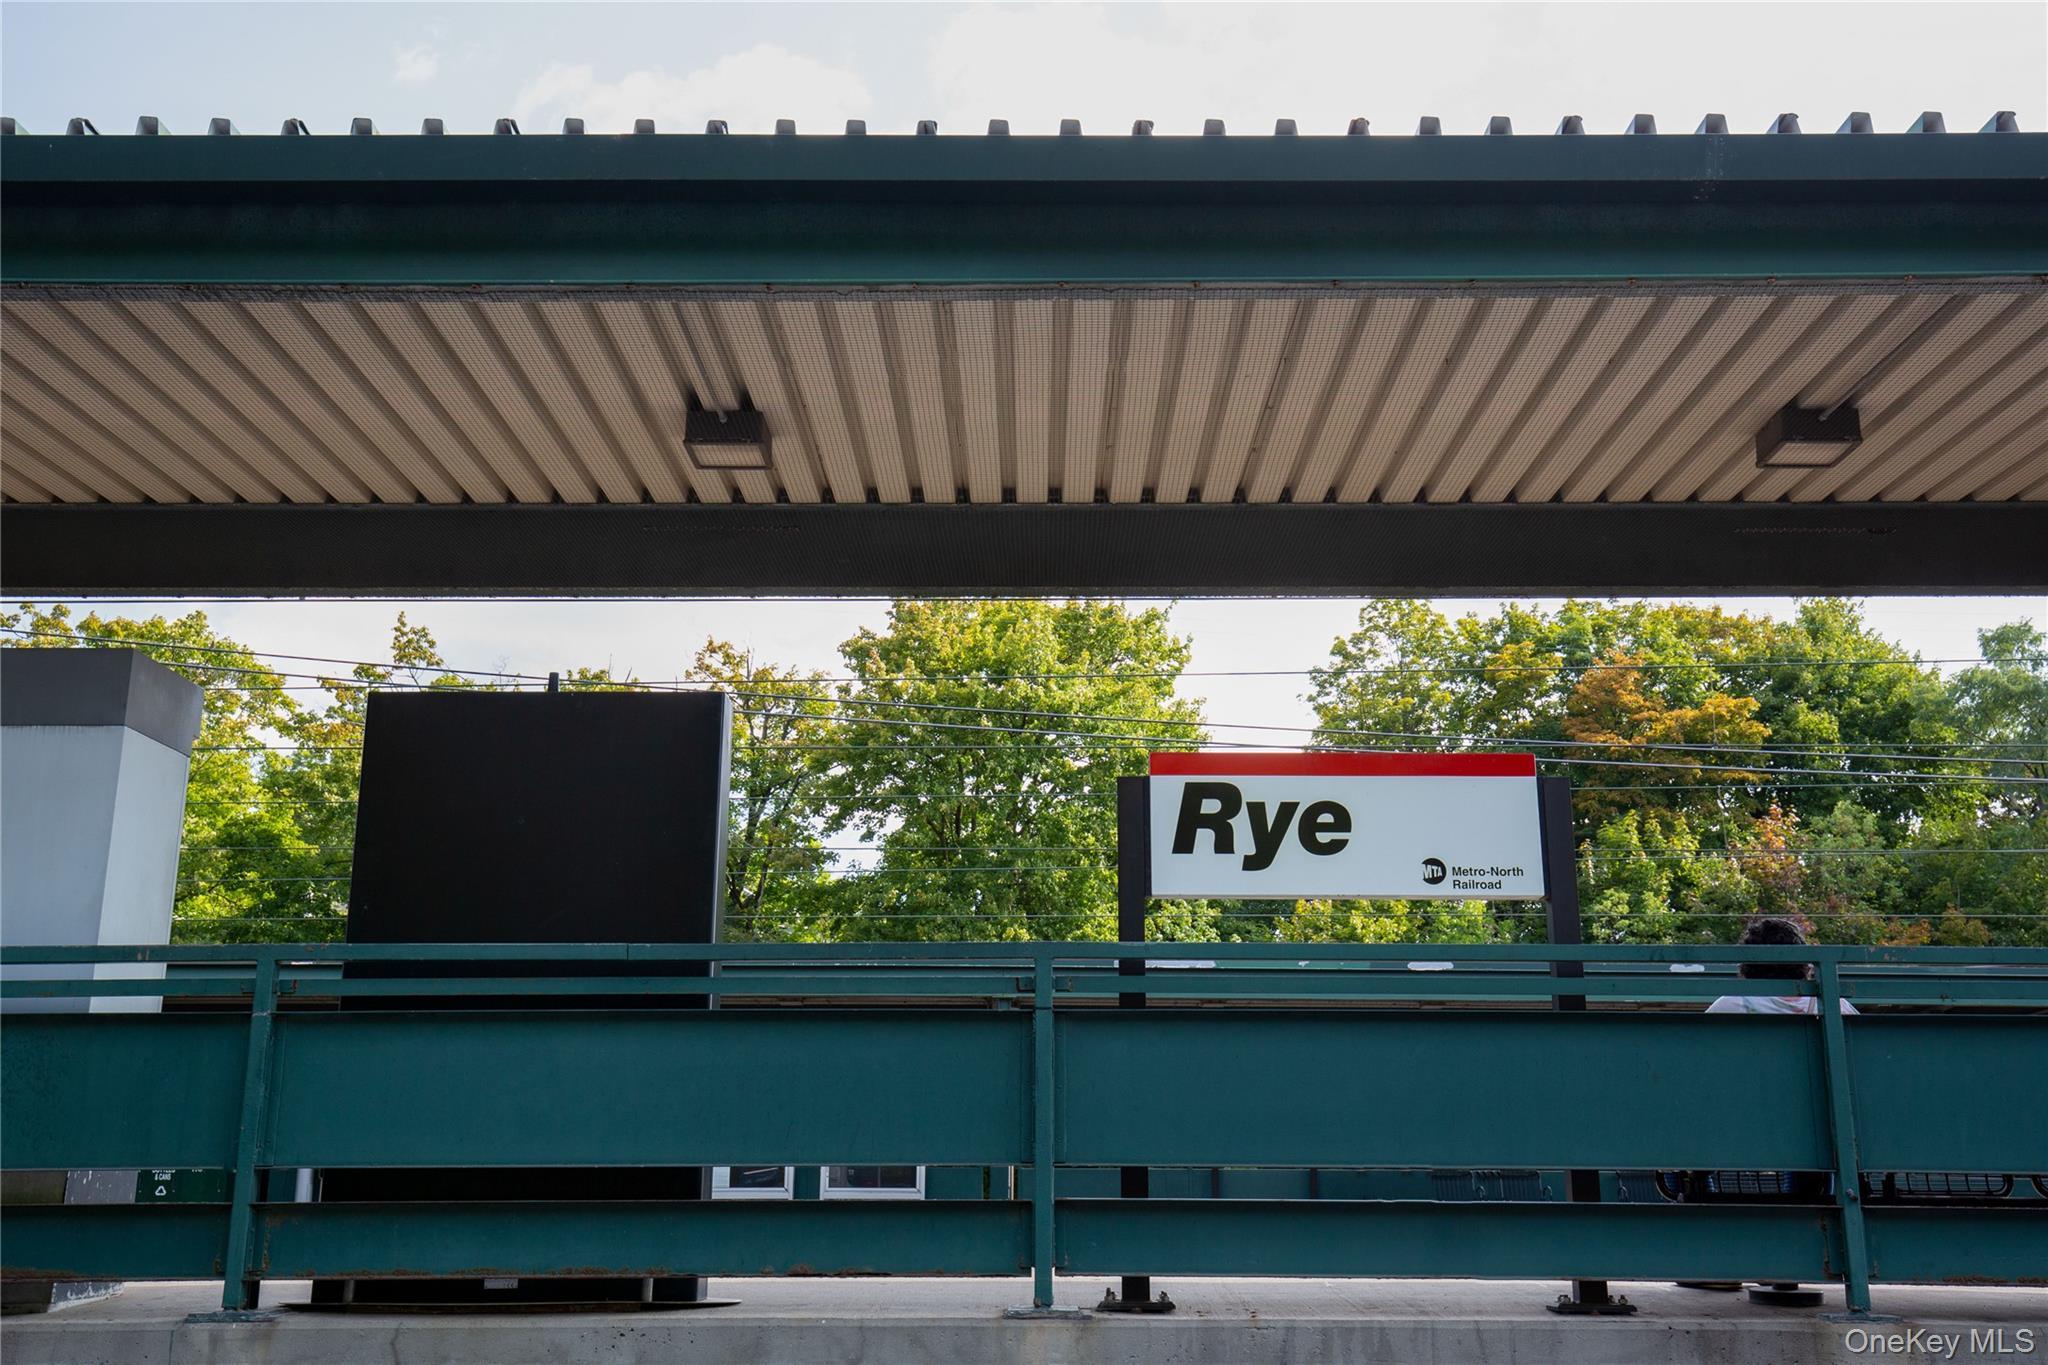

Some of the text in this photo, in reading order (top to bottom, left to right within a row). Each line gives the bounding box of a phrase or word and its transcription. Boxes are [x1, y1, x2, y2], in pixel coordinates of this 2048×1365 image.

[1171, 781, 1353, 871] Rye
[1422, 862, 1444, 880] MTA
[1452, 866, 1524, 877] Metro-North
[1453, 879, 1502, 890] Railroad
[159, 1173, 172, 1181] CANS
